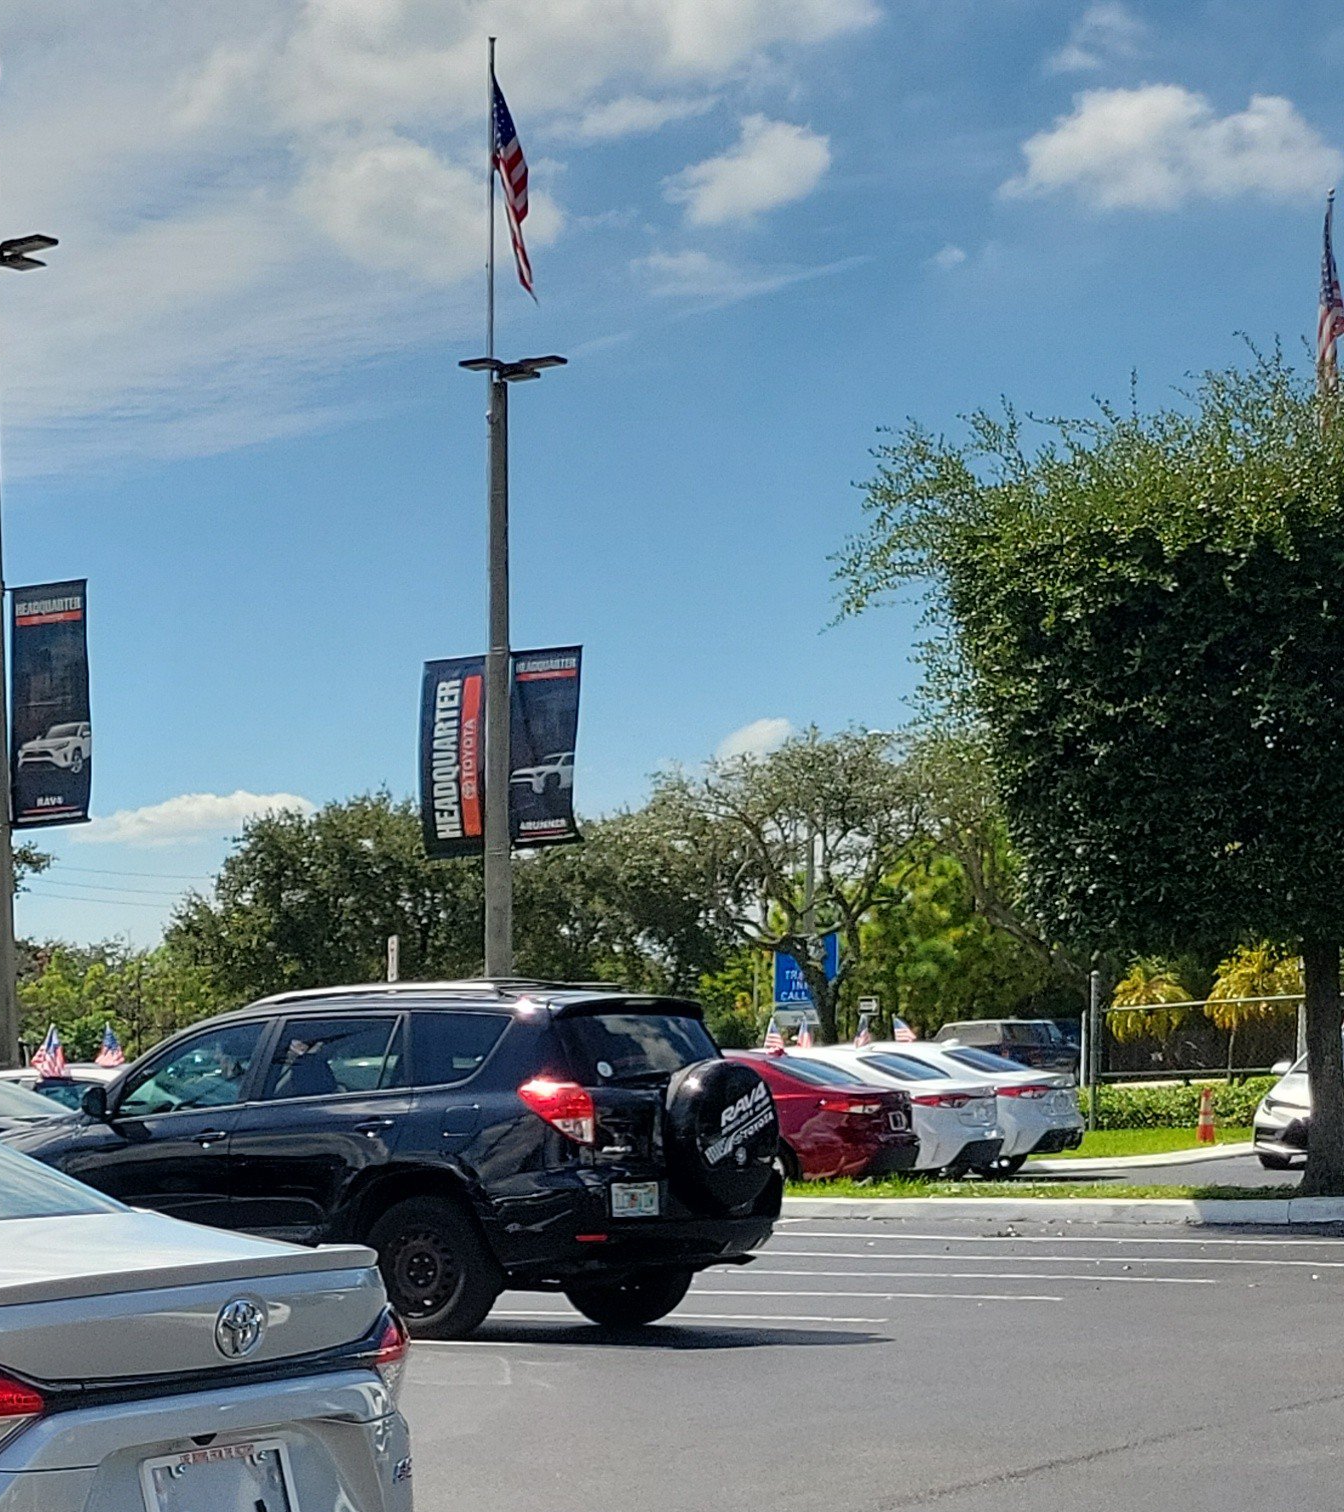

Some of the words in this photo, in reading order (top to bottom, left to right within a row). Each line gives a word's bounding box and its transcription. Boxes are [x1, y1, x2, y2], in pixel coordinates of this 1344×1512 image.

[432, 679, 463, 839] HEADQUARTER
[780, 991, 808, 1001] CALL
[720, 1081, 767, 1128] RAV4
